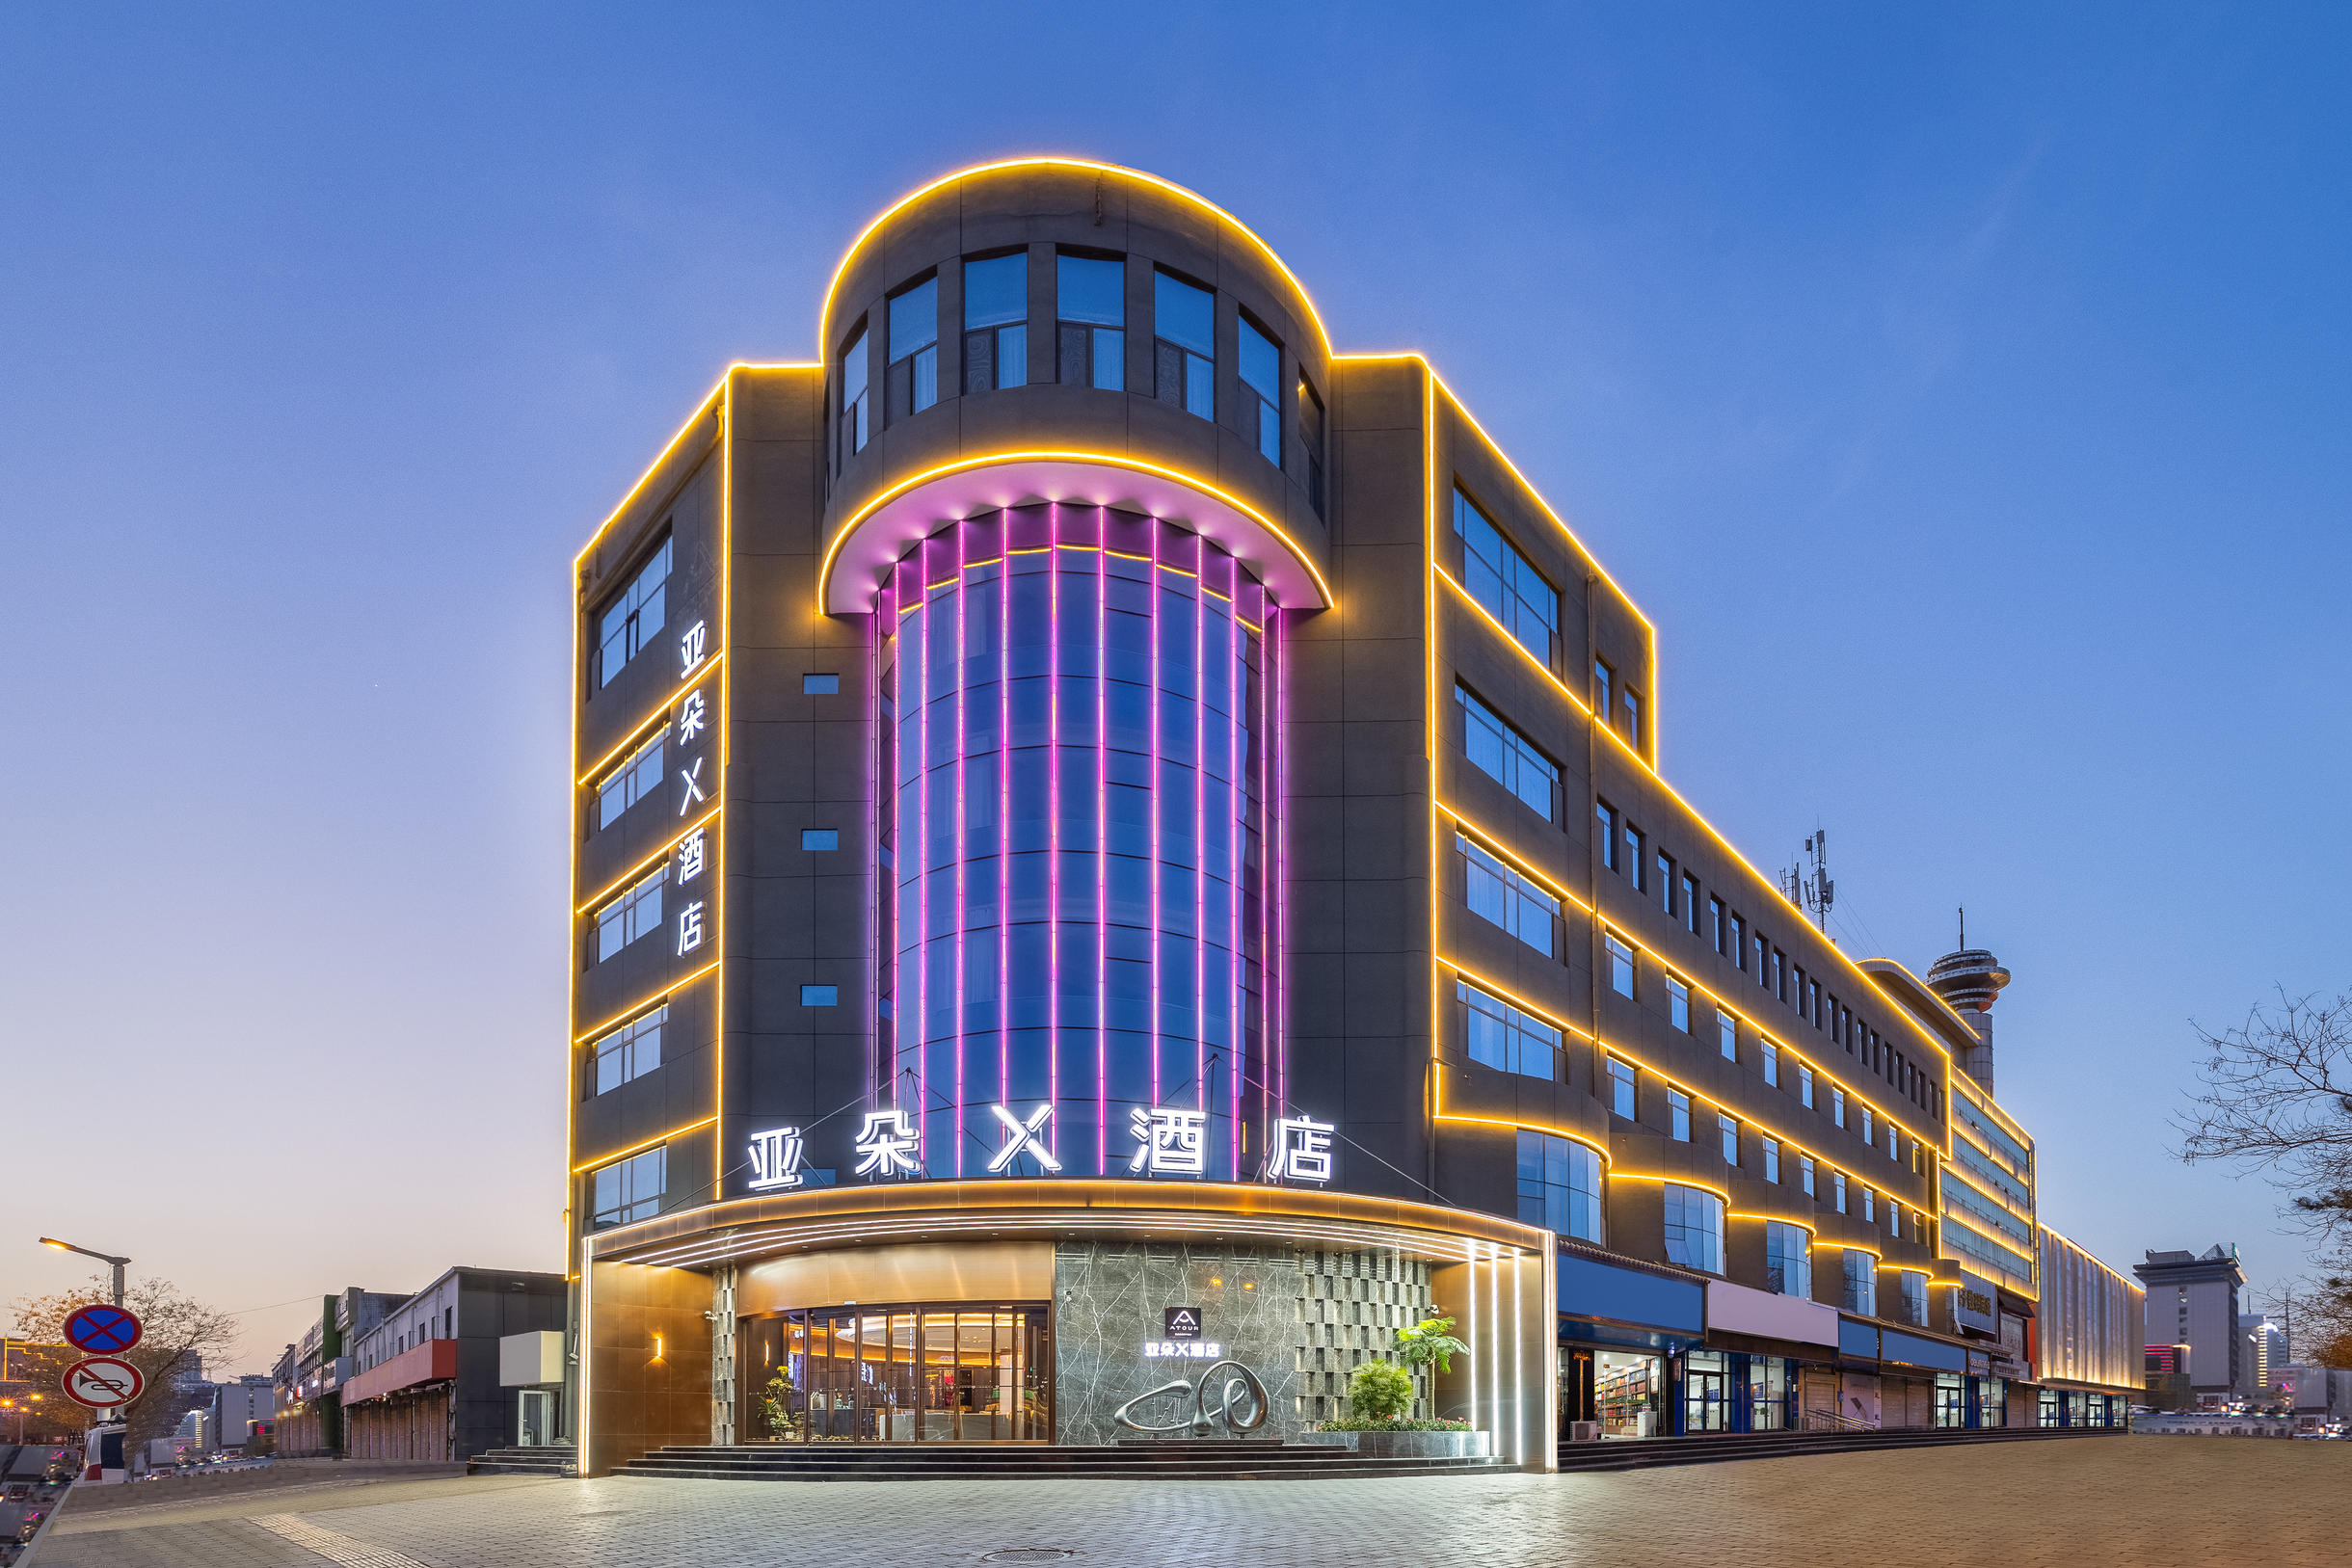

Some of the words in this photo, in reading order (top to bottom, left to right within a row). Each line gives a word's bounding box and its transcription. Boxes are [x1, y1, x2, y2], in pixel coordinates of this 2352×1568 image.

[677, 620, 705, 957] 亚朵X酒店
[748, 1104, 1336, 1190] 亚朵X酒店
